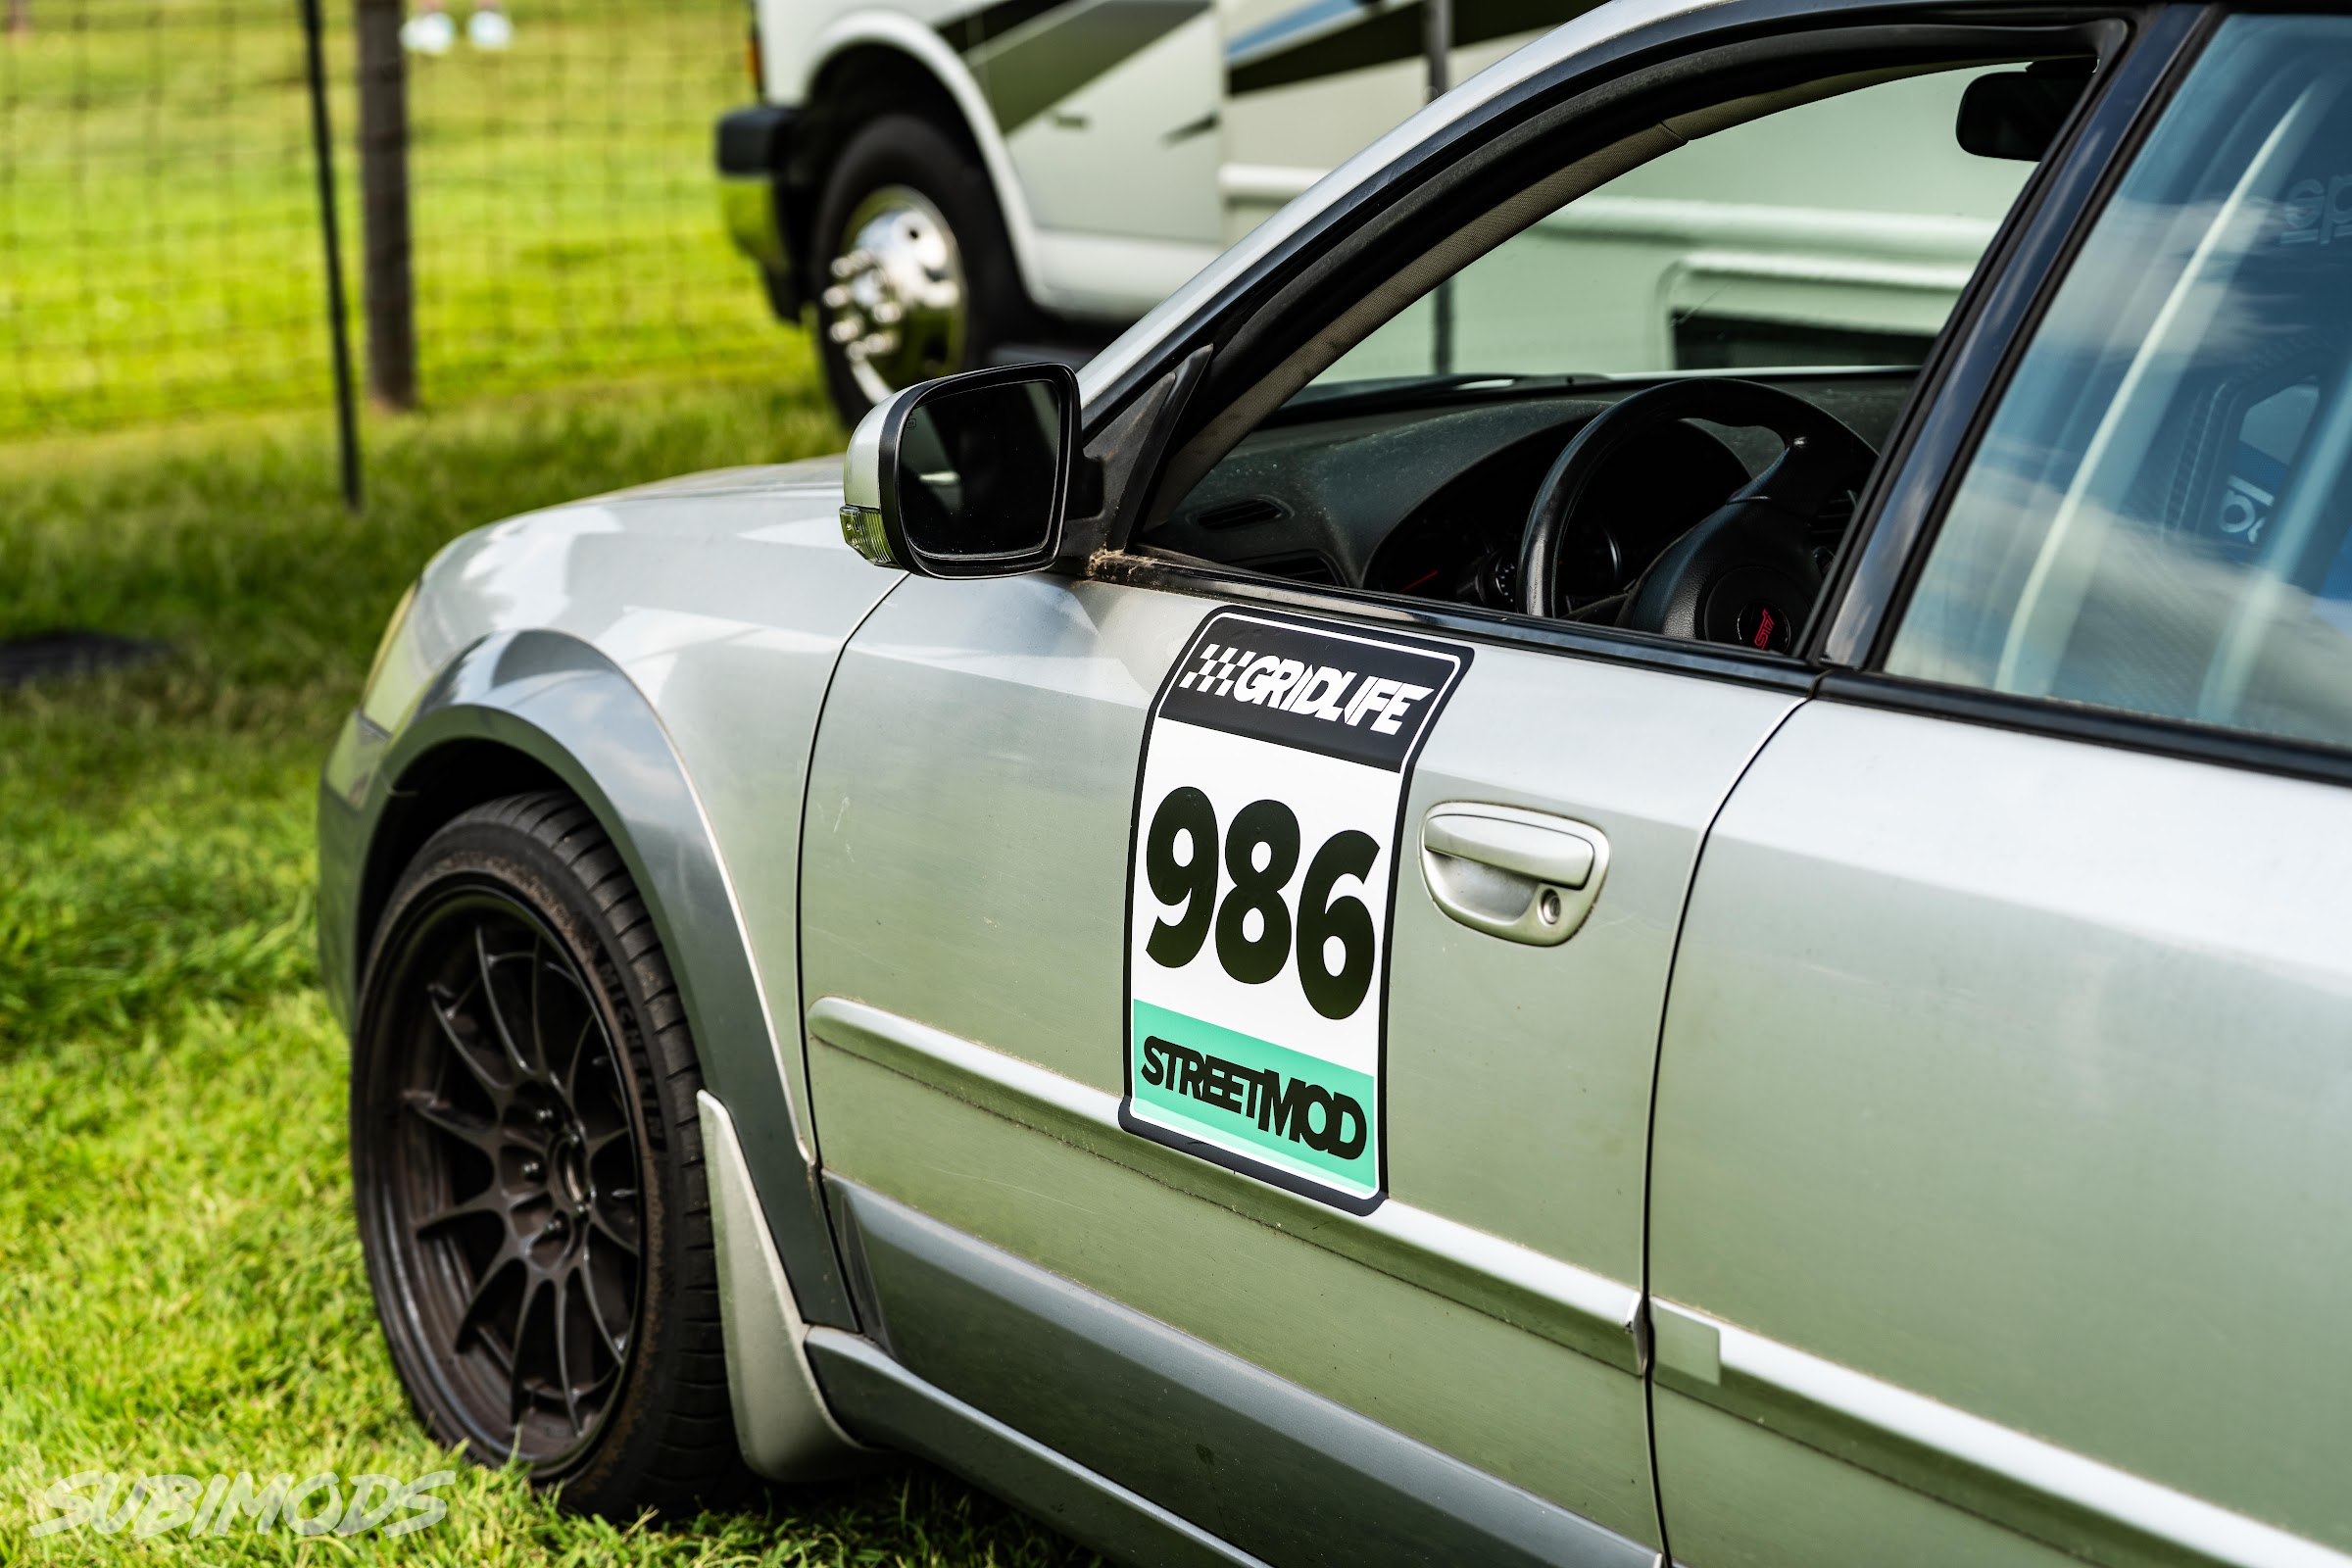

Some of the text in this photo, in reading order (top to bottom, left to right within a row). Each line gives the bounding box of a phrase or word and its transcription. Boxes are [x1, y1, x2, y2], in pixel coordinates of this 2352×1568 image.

[1233, 655, 1435, 736] GRIDLIFE
[1146, 786, 1381, 1020] 986
[597, 960, 665, 1140] MICHELIN
